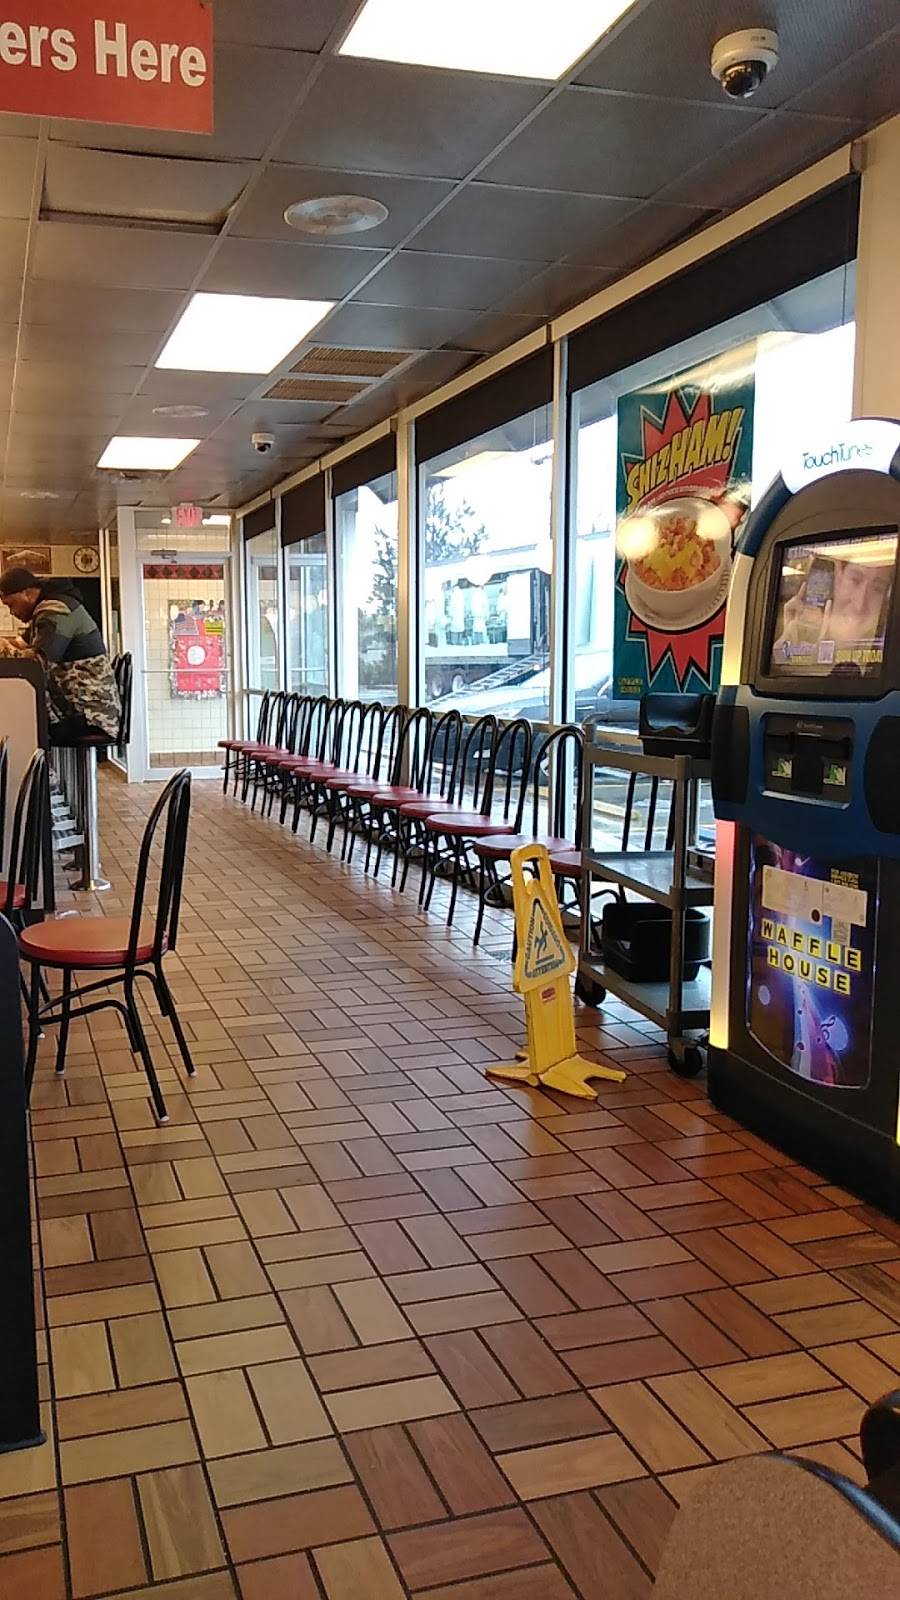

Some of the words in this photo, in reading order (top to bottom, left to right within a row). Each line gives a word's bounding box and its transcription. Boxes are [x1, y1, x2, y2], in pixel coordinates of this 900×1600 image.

[0, 21, 78, 72] ers
[94, 19, 207, 87] Here
[626, 405, 745, 514] SHIZHAM!
[176, 507, 201, 526] EXIT
[762, 920, 860, 969] WAFFLE
[768, 947, 849, 992] HOUSE
